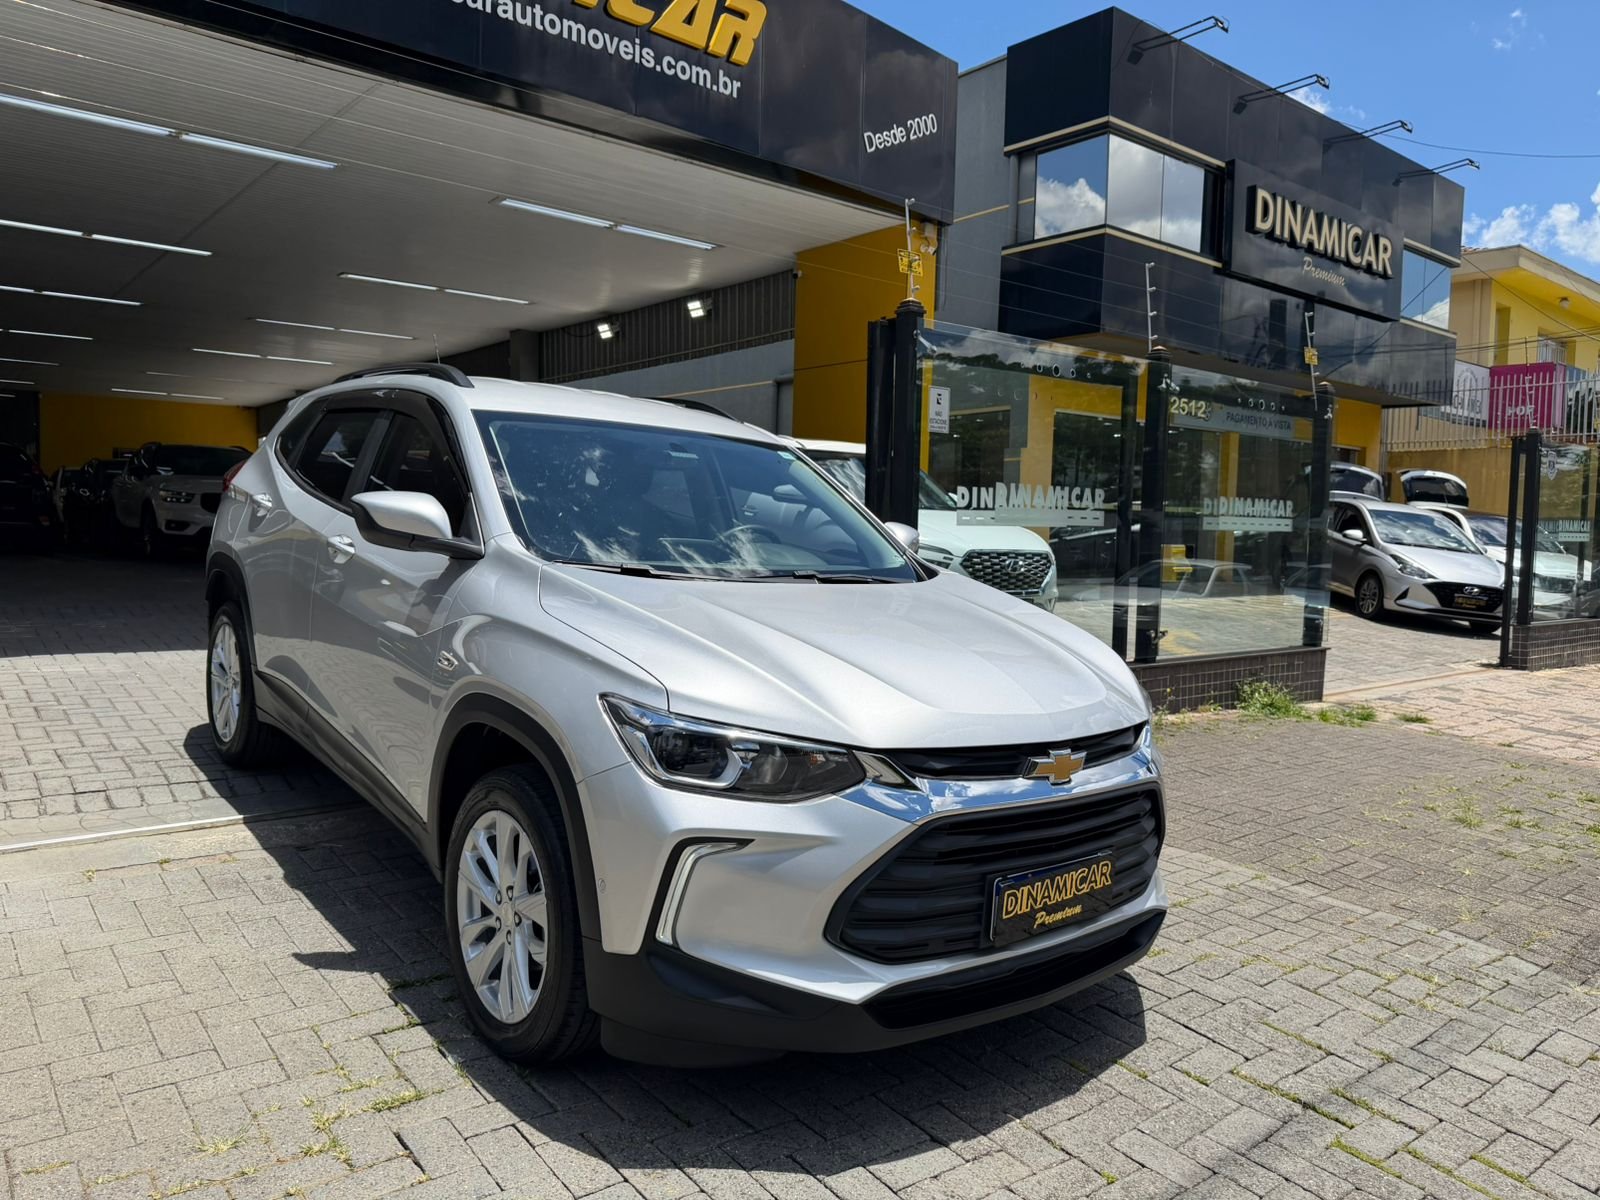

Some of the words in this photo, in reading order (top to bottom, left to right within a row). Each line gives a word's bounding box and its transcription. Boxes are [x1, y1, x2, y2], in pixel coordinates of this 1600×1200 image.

[863, 124, 907, 153] Desde
[907, 113, 938, 140] 2000
[1254, 187, 1393, 277] DINAMICAR
[1302, 256, 1346, 287] Premium
[1169, 396, 1206, 418] 2512
[1226, 411, 1267, 428] PAGAMENTO
[1002, 860, 1113, 919] DINAMICAR
[1033, 904, 1083, 929] Premium
